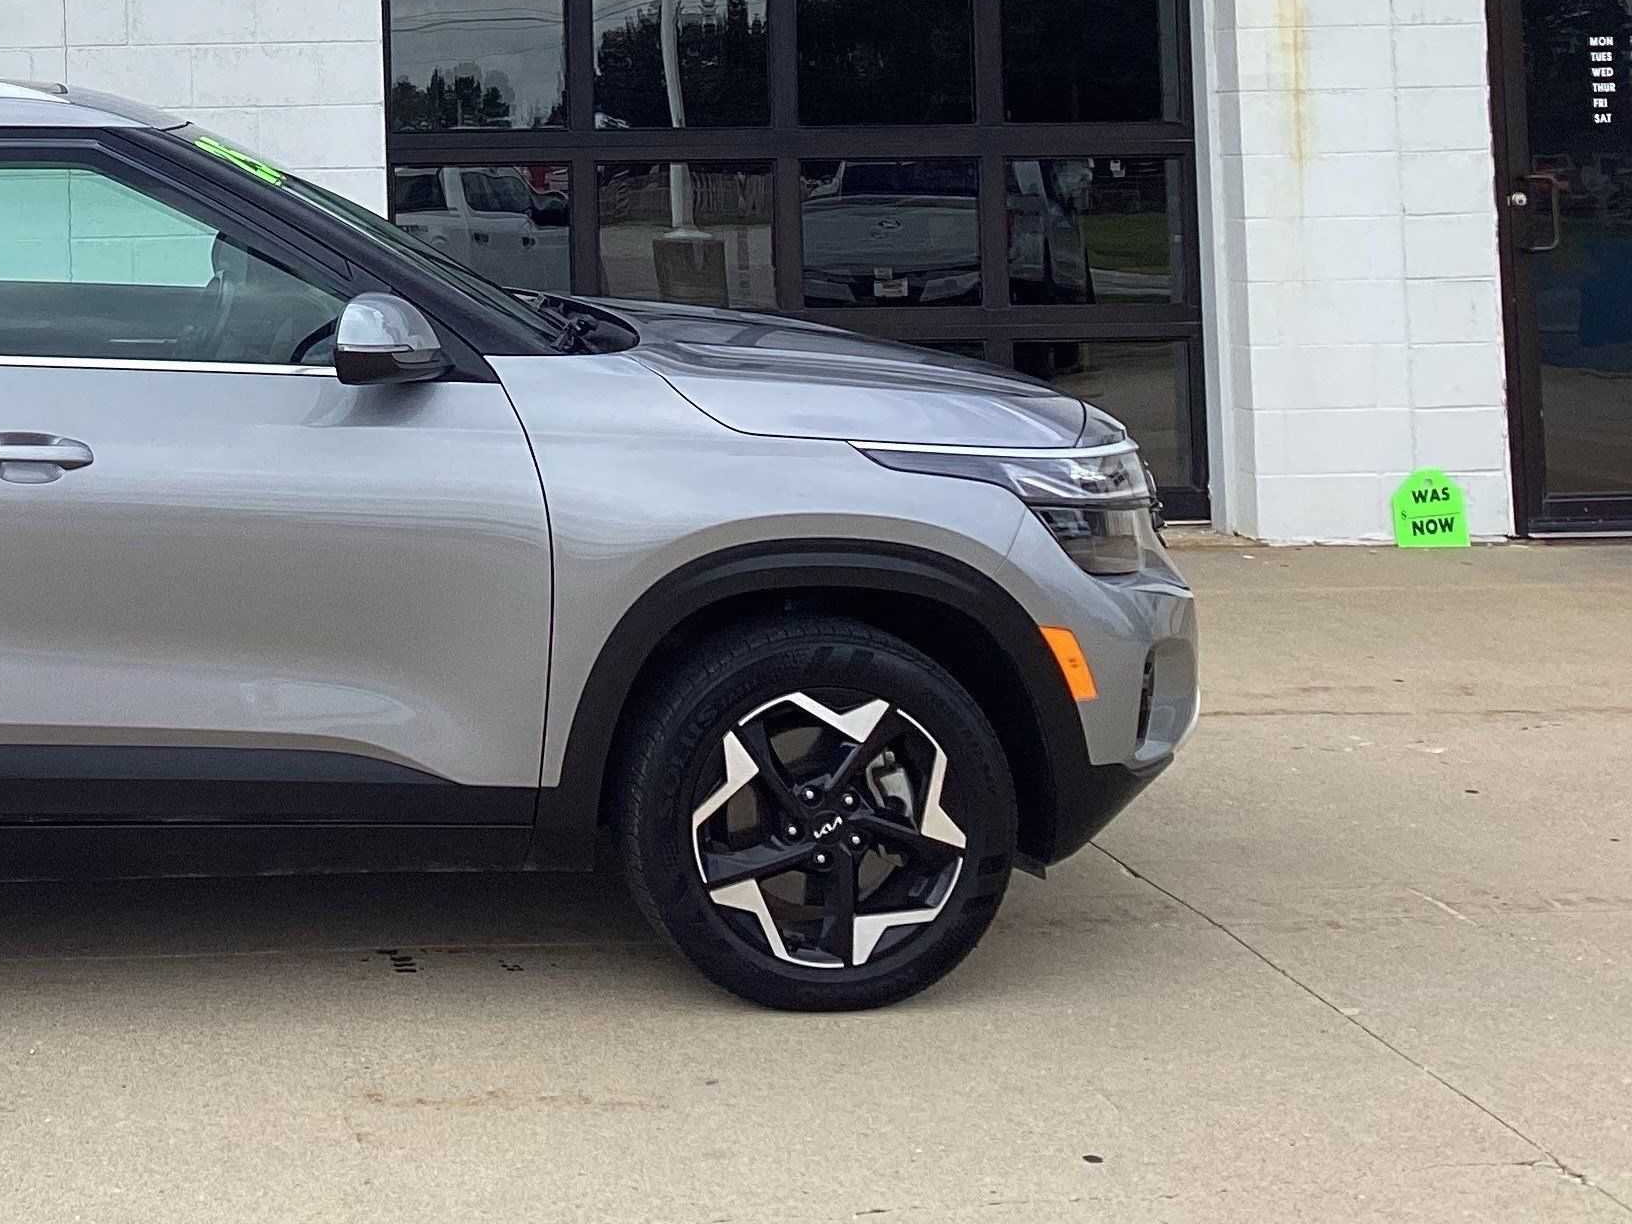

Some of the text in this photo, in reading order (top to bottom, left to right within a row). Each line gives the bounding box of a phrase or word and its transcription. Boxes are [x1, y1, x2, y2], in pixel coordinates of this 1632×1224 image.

[1589, 36, 1614, 46] MON
[1590, 51, 1613, 62] TUES
[1591, 67, 1614, 77] WED
[1592, 82, 1616, 93] THUR
[1593, 97, 1608, 108] FRI
[1594, 113, 1612, 123] SAT
[1411, 487, 1451, 504] WAS
[1411, 517, 1455, 536] NOW
